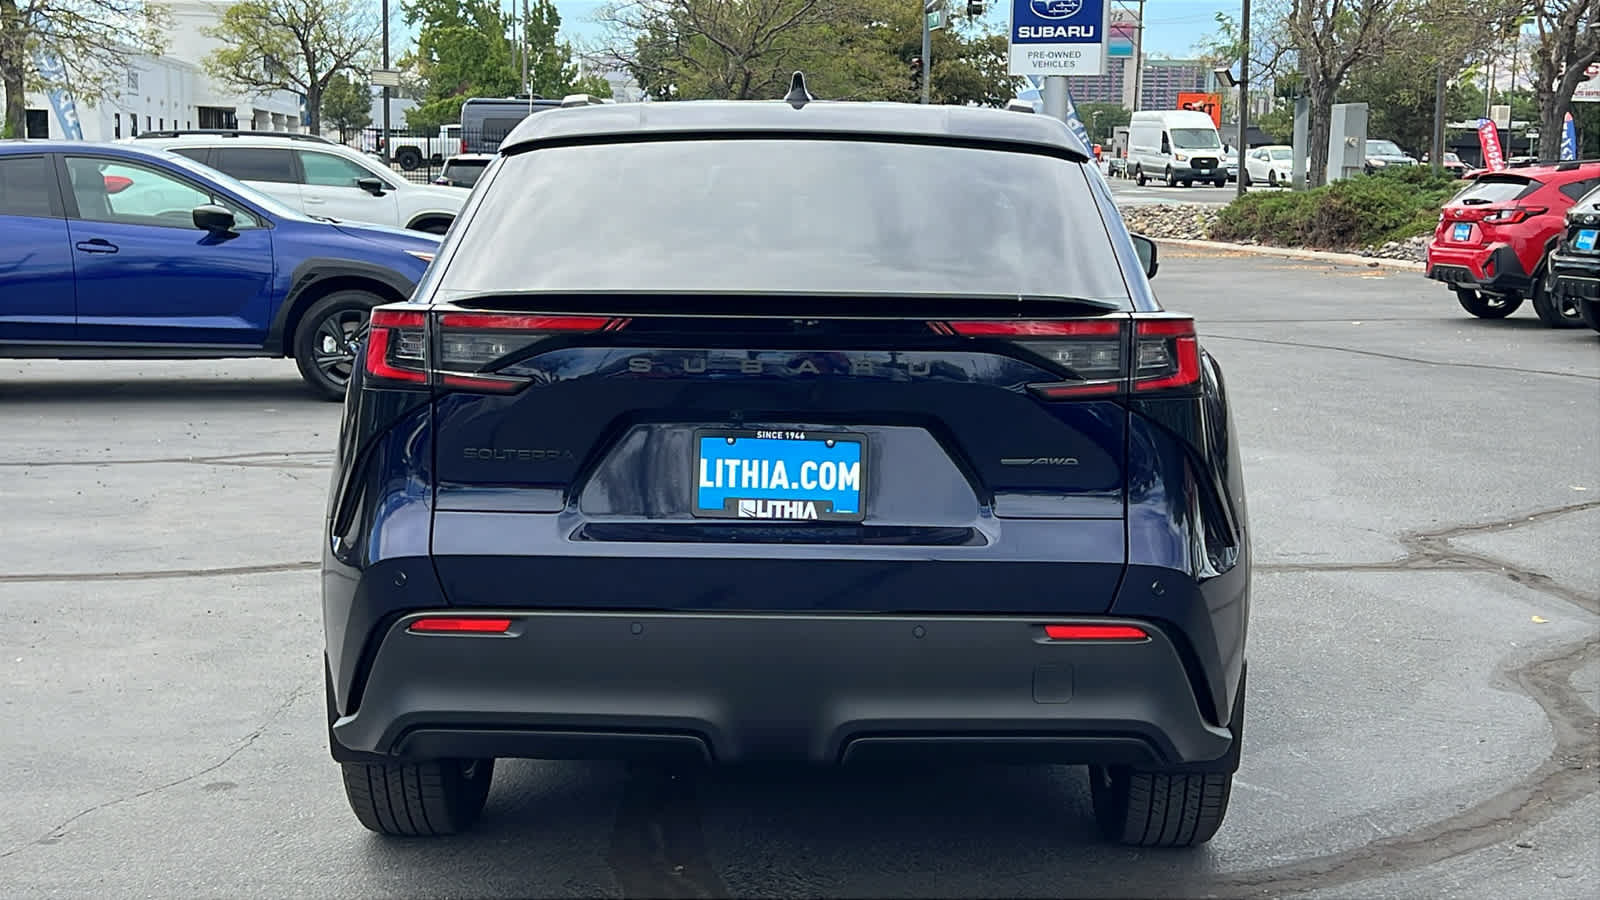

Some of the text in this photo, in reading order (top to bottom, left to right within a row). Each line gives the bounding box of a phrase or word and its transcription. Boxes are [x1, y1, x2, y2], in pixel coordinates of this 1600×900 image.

[1018, 26, 1094, 38] SUBARU
[1027, 51, 1082, 59] PRE-OWNED
[1032, 60, 1076, 69] VEHICLES
[1182, 102, 1216, 117] SXT
[628, 356, 931, 376] SUBARU
[756, 430, 806, 440] SINCE 1946
[1031, 457, 1079, 465] AWD
[699, 457, 861, 491] LITHIA.COM
[756, 499, 818, 519] LITHIA
